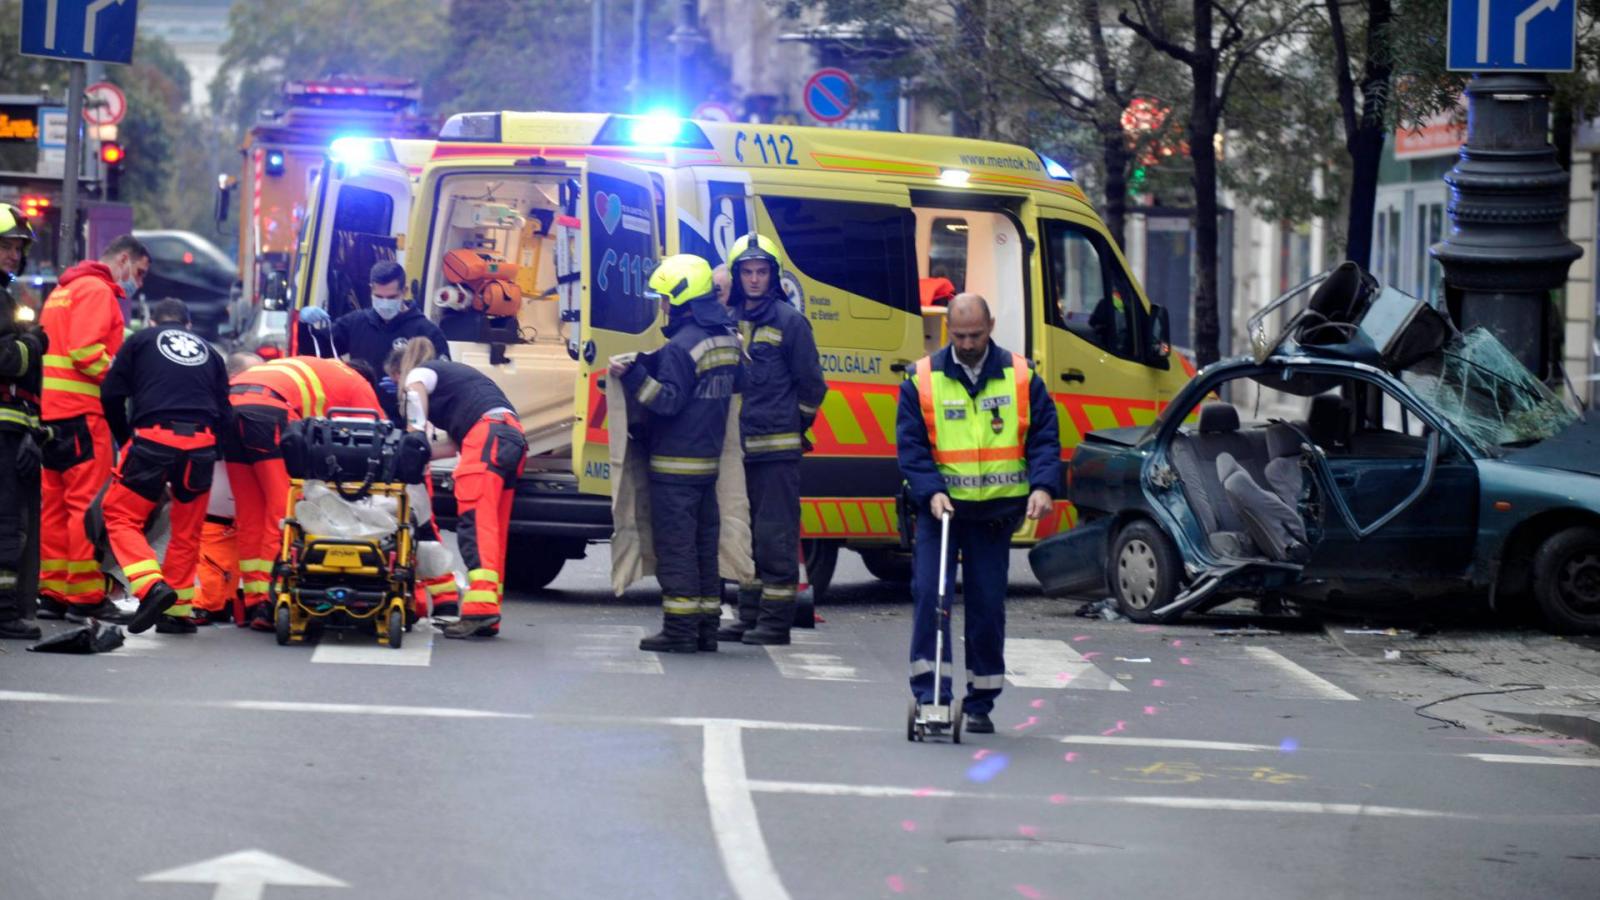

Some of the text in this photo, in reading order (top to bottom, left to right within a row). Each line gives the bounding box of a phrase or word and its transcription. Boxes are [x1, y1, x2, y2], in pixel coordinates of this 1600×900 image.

[754, 132, 799, 165] 112
[959, 154, 1041, 172] www.mentok.hu
[820, 351, 882, 375] ZOLGÁLAT
[983, 396, 1009, 410] POICE
[584, 460, 610, 480] AMB
[942, 474, 980, 488] OLICE
